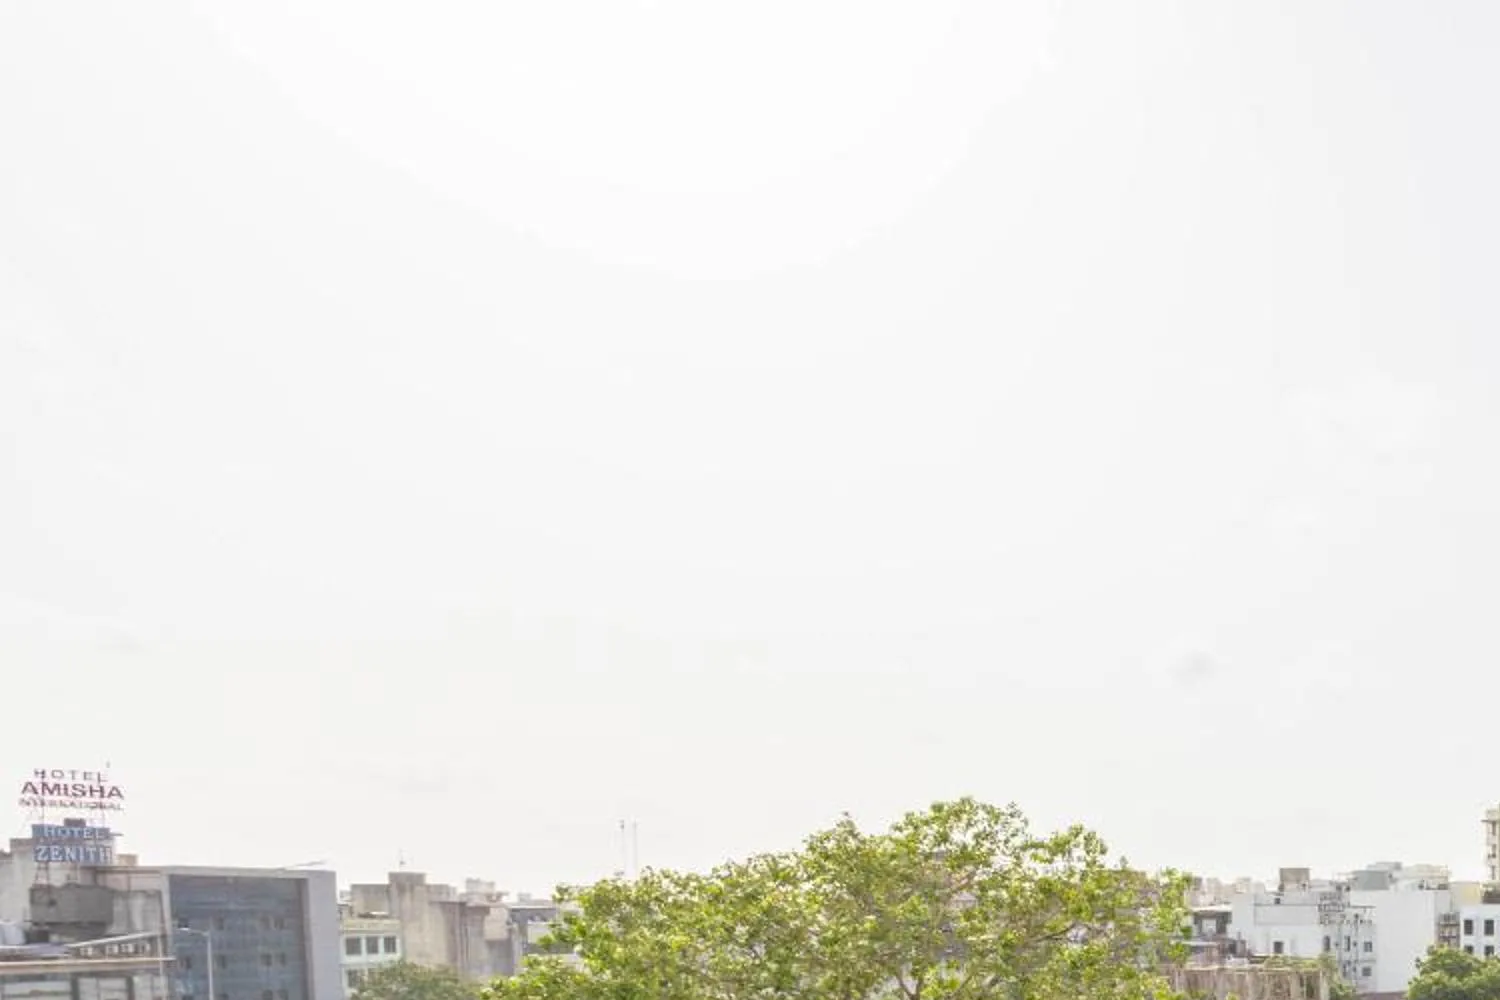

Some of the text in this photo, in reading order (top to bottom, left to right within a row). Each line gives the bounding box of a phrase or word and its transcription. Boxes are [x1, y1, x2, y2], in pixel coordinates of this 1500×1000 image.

[33, 768, 109, 783] HOTEL
[21, 781, 125, 800] AMISHA
[43, 826, 108, 841] HOTEL
[35, 843, 113, 864] ZENITH
